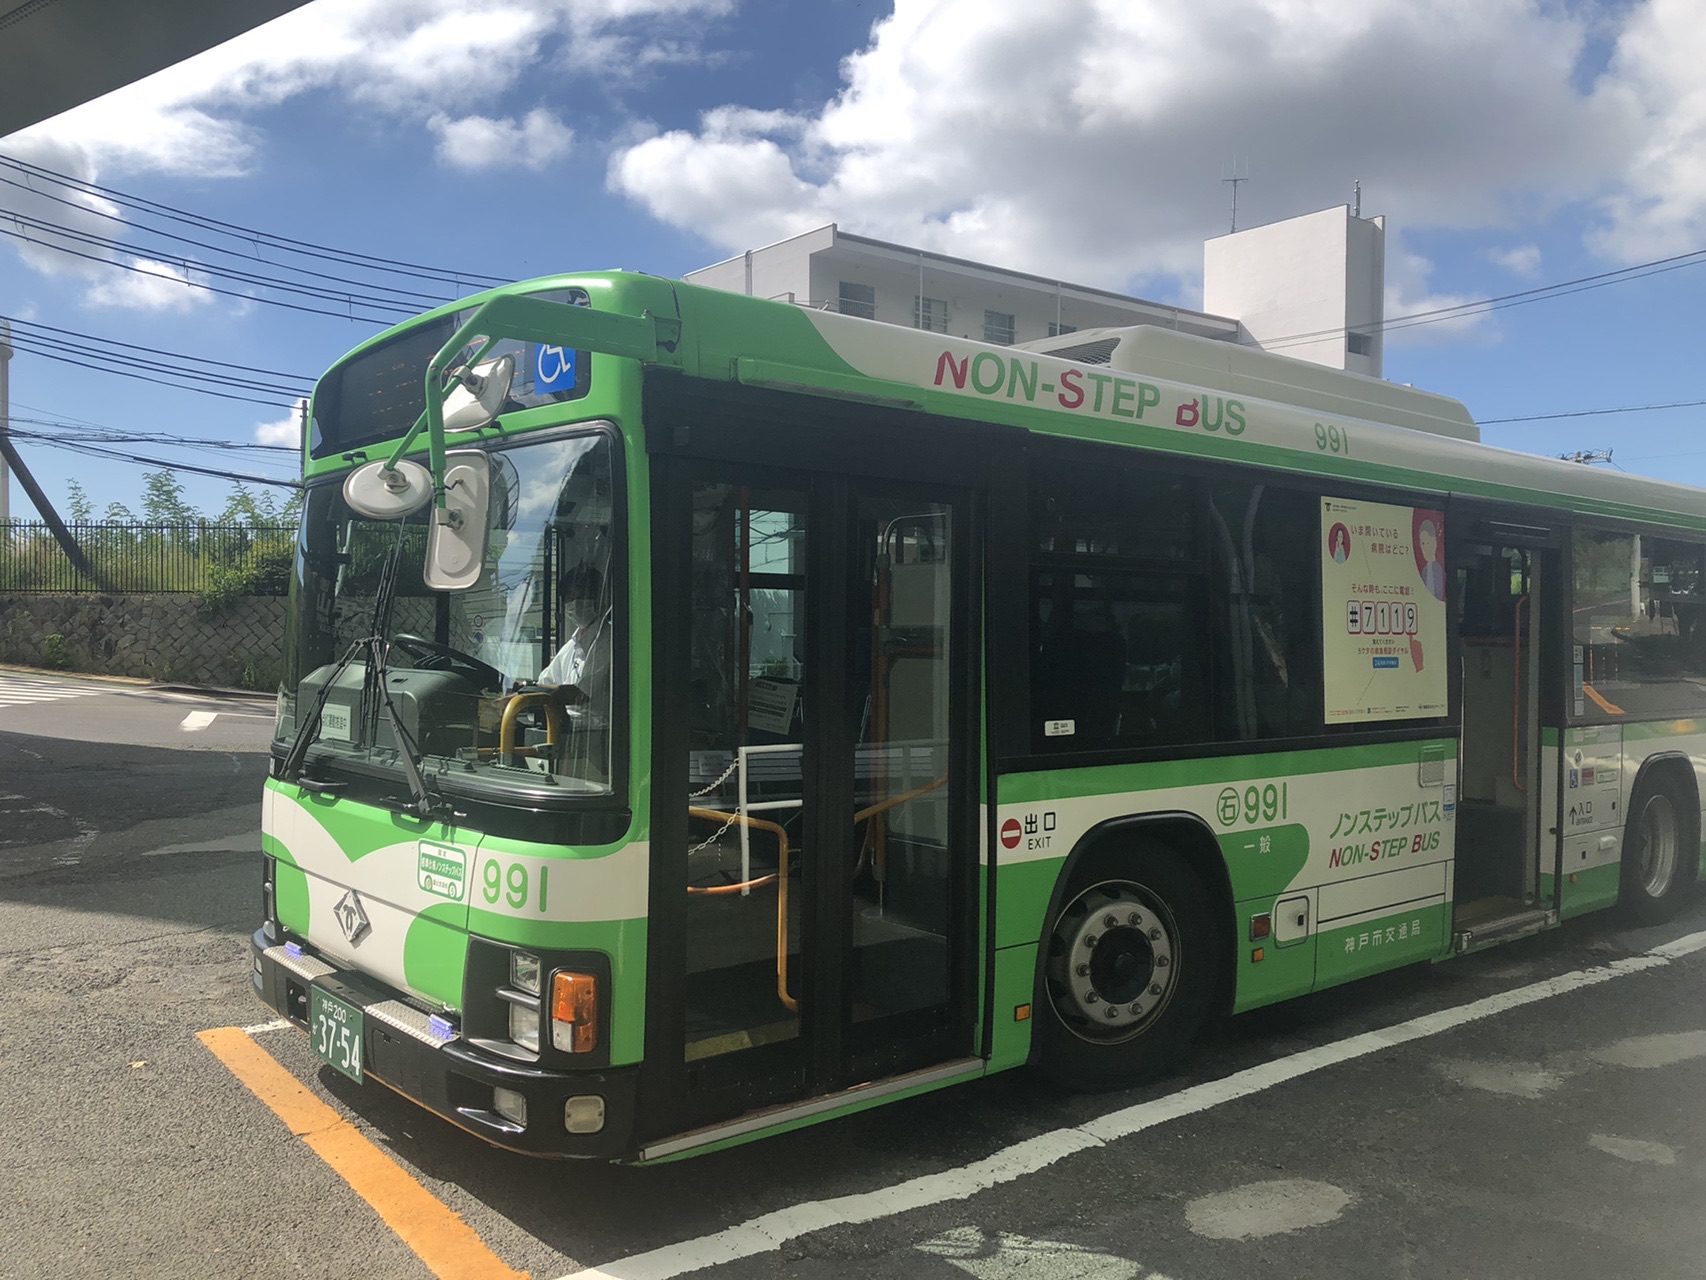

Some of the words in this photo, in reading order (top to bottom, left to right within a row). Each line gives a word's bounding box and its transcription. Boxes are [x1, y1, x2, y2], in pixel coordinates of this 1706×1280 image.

[934, 351, 1161, 419] NON-STEP
[1175, 394, 1246, 436] BUS
[1314, 422, 1349, 455] 991
[1350, 605, 1415, 628] #7119
[1244, 782, 1287, 824] 991
[1329, 800, 1441, 839] ノンステップバス
[1024, 811, 1056, 834] 出口
[1027, 836, 1052, 850] EXIT
[1243, 835, 1271, 854] 一般
[1328, 837, 1408, 869] NON-STEP
[1411, 831, 1441, 853] BUS
[482, 858, 549, 912] 991
[1344, 919, 1421, 954] 神戸市交通局
[333, 1004, 347, 1024] 200
[319, 1014, 360, 1076] 37-54
